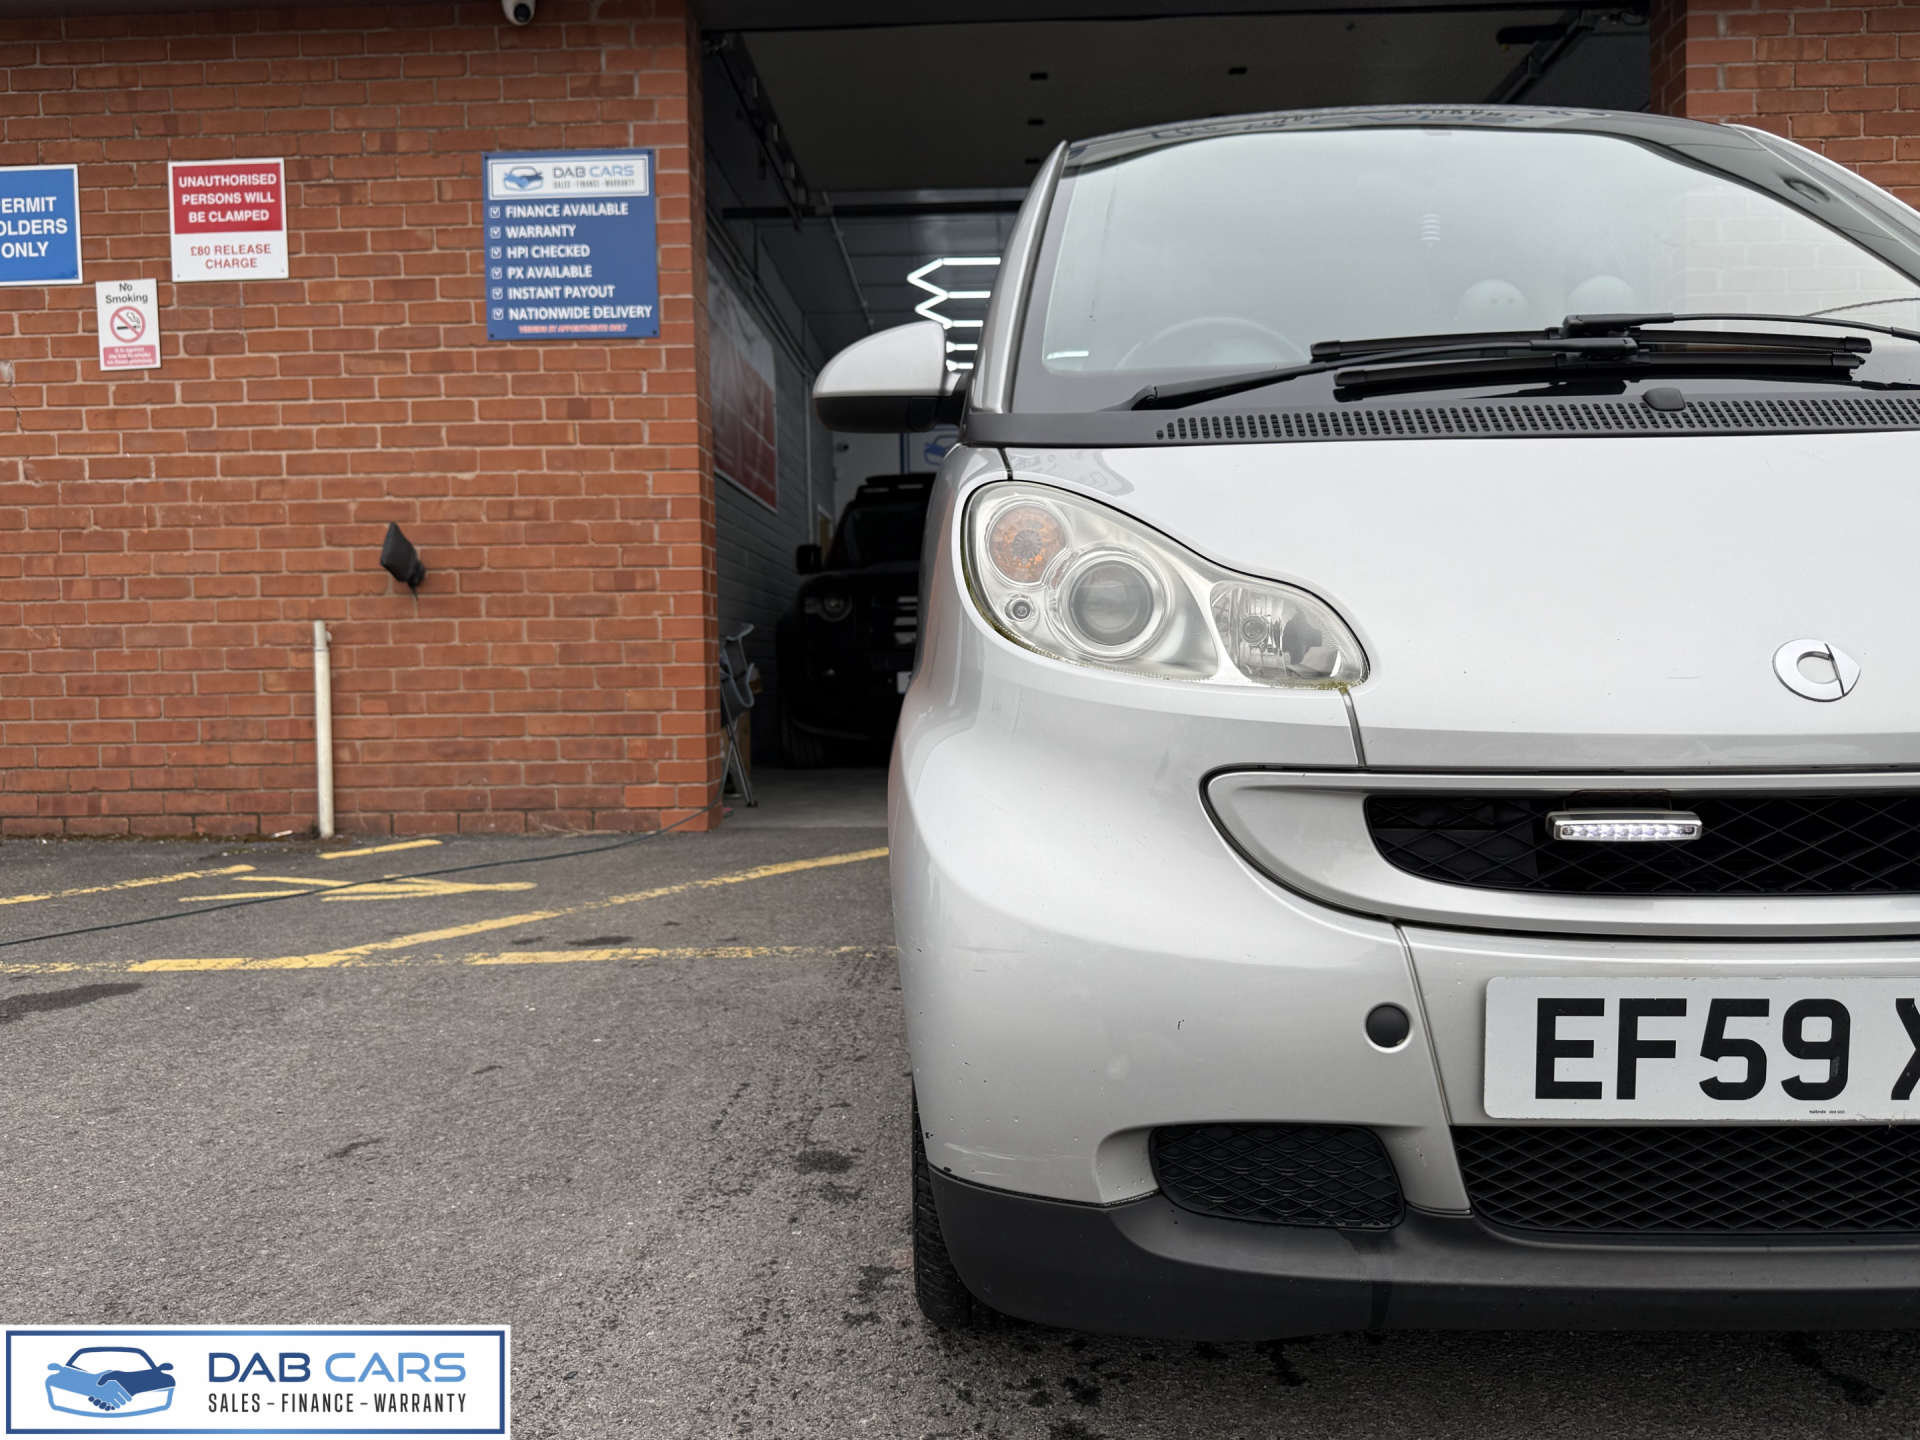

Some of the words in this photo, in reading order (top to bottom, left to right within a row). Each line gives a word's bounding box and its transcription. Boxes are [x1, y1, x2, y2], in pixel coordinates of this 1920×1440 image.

[553, 167, 586, 179] DAB
[589, 165, 635, 177] CARS
[178, 173, 277, 188] UNAUTHORISED
[1, 196, 57, 214] ERMIT
[182, 192, 243, 205] PERSONS
[243, 191, 275, 203] WILL
[188, 211, 206, 223] BE
[208, 209, 270, 222] CLAMPED
[505, 204, 560, 218] FINANCE
[562, 203, 629, 217] AVAILABLE
[505, 224, 576, 239] WARRANTY
[1, 241, 49, 258] ONLY
[190, 245, 211, 256] £80
[214, 243, 272, 255] RELEASE
[507, 246, 529, 259] HPI
[531, 244, 591, 259] CHECKED
[205, 257, 258, 270] CHARGE
[507, 267, 524, 279] PX
[526, 265, 593, 279] AVAILABLE
[119, 282, 133, 292] No
[507, 286, 562, 300] INSTANT
[564, 285, 616, 299] PAYOUT
[105, 293, 149, 304] Smoking
[508, 306, 591, 321] NATIONWIDE
[593, 305, 653, 320] DELIVERY
[1535, 997, 1852, 1101] EF59
